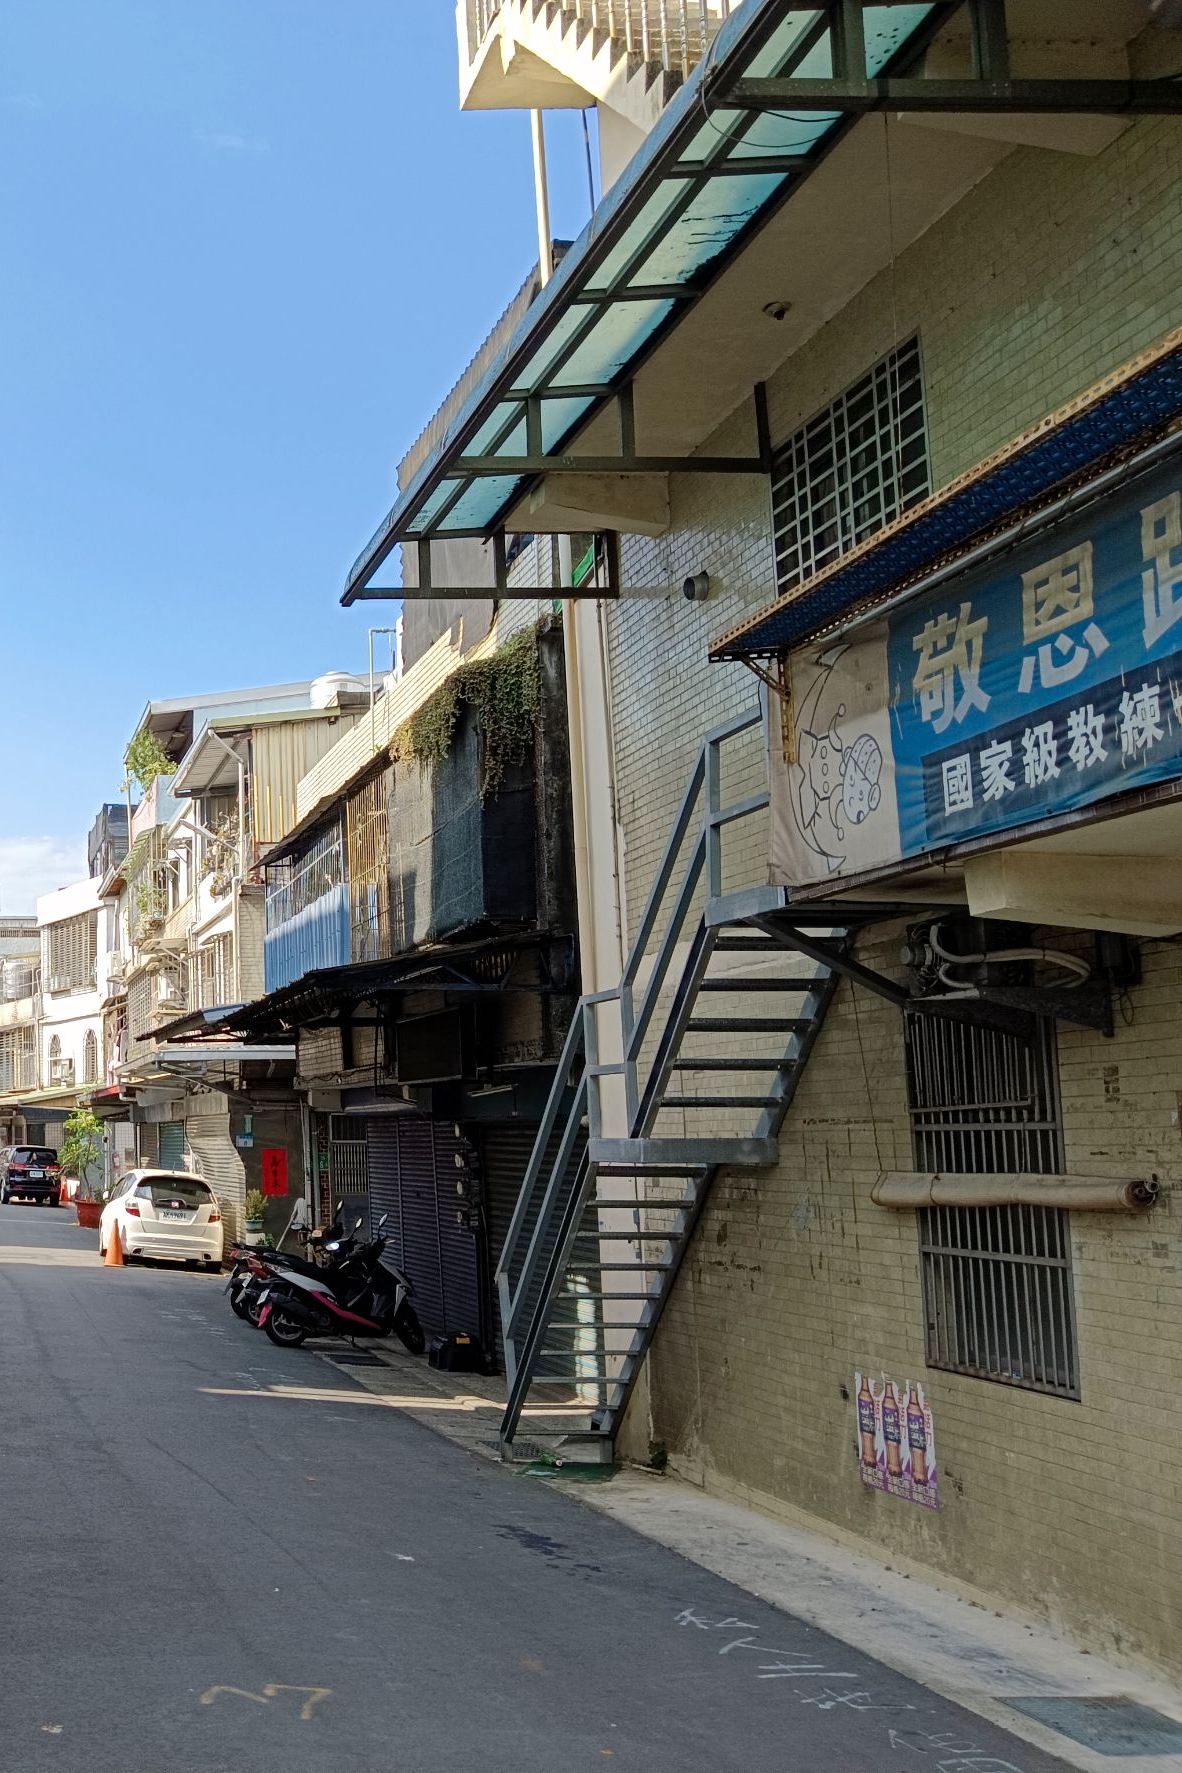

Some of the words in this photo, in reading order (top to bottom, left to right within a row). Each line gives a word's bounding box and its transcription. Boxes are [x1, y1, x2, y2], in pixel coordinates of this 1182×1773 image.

[941, 678, 1182, 816] 國家級教練
